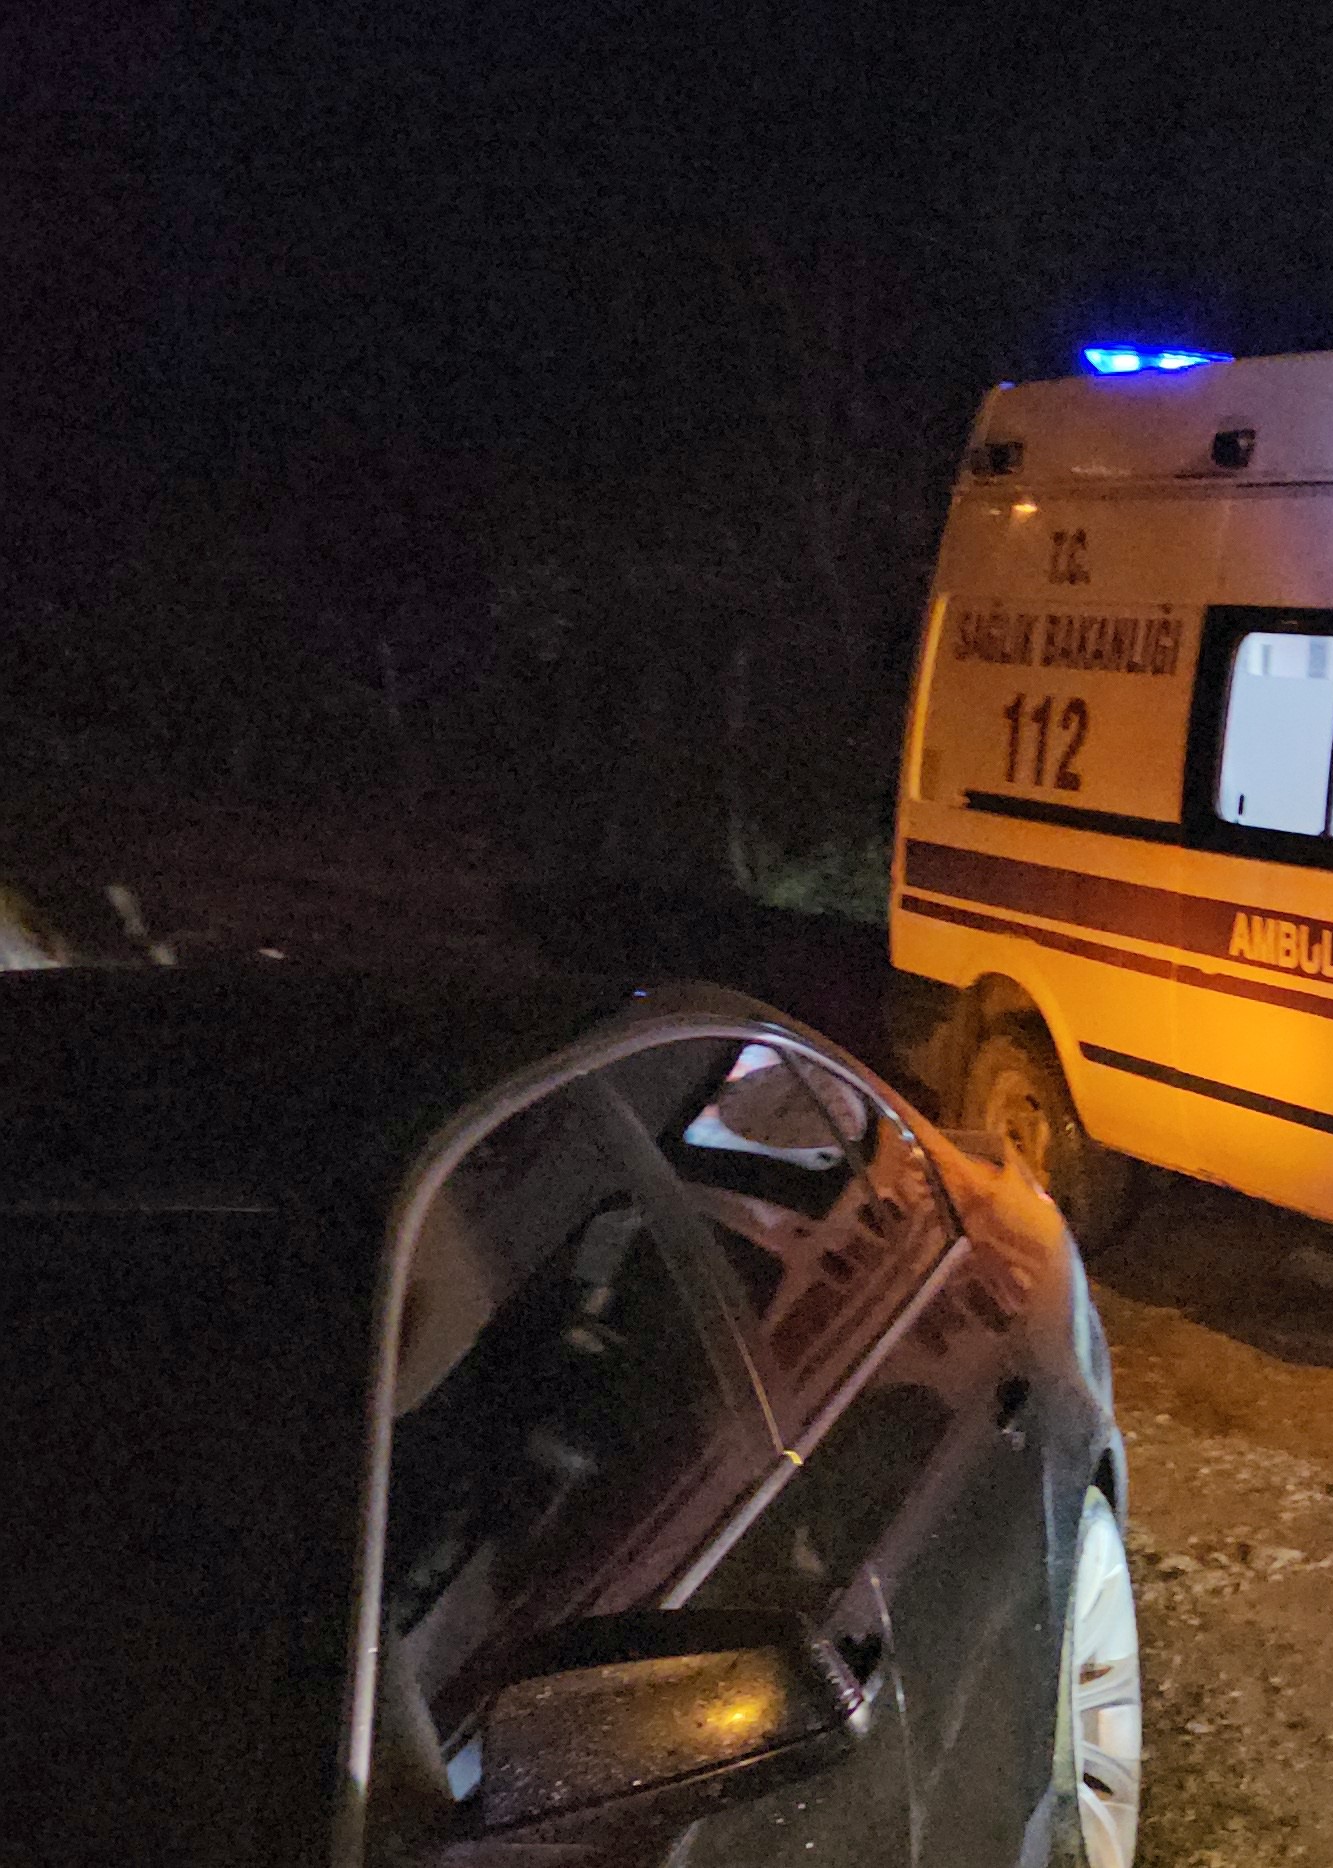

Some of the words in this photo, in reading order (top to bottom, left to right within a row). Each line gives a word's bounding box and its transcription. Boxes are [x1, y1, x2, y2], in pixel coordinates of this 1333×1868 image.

[955, 601, 1039, 667] SAĞLIK
[1040, 602, 1183, 676] BAKANLIĞI
[1003, 693, 1088, 791] 112
